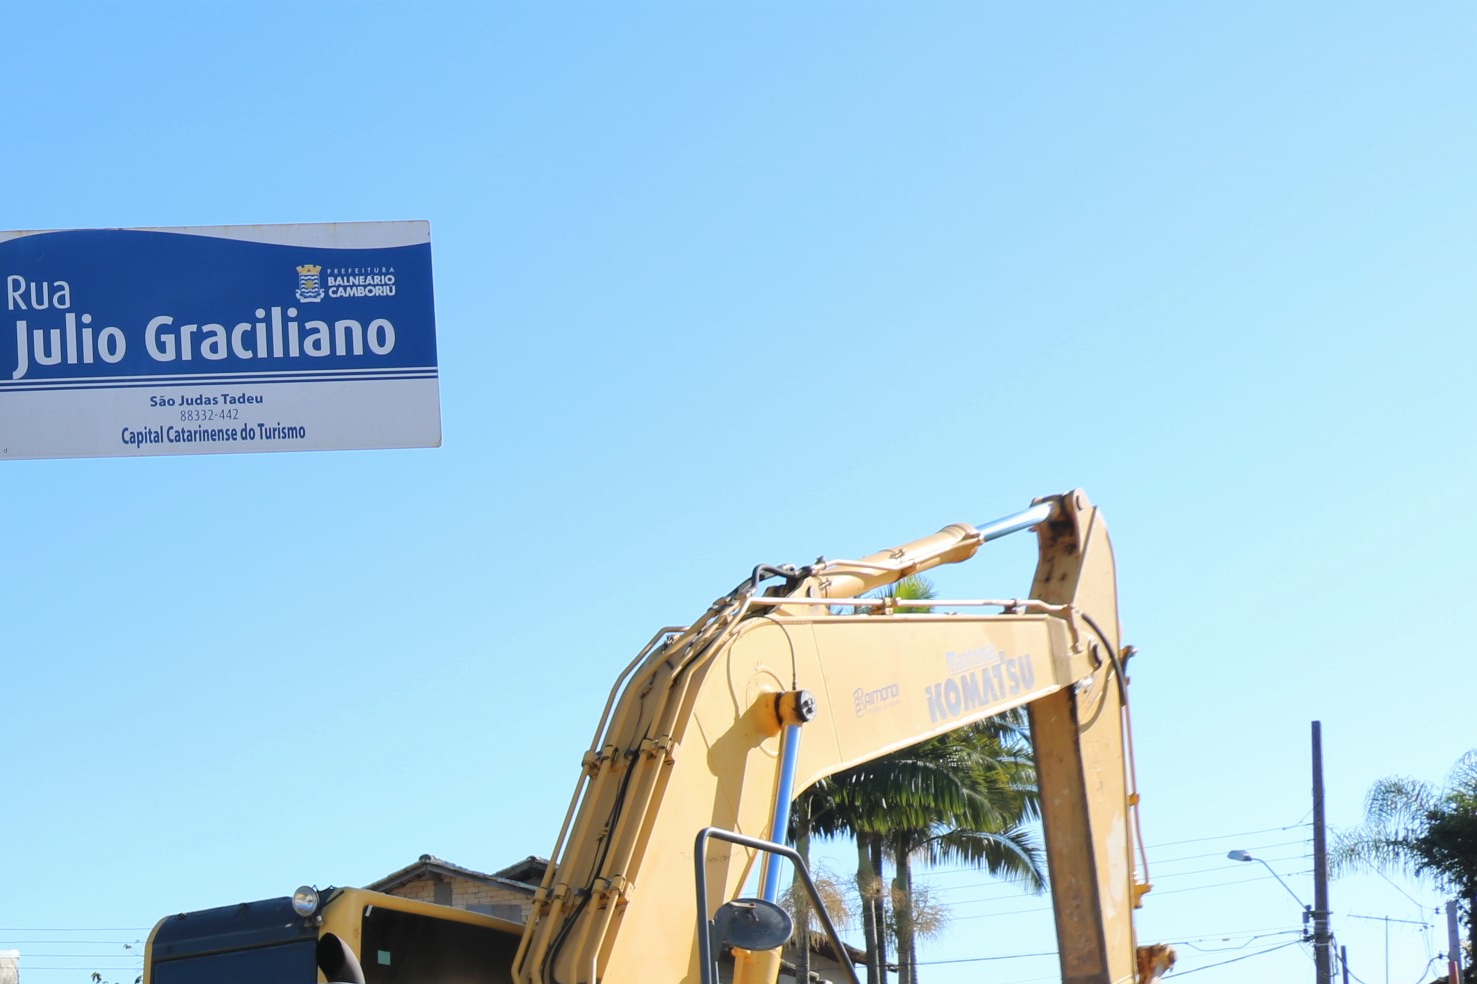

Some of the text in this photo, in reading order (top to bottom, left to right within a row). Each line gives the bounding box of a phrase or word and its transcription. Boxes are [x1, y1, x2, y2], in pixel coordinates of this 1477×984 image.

[328, 274, 395, 286] BALNEÁRIO
[7, 275, 71, 310] Rua
[328, 285, 396, 297] CAMBORIÚ
[12, 306, 396, 380] Julio Graciliano
[150, 393, 264, 407] São Judas Tadeu
[180, 408, 239, 422] 88332-442
[122, 422, 306, 448] Capital Catarinense do Turismo
[925, 651, 1035, 723] KOMATSU
